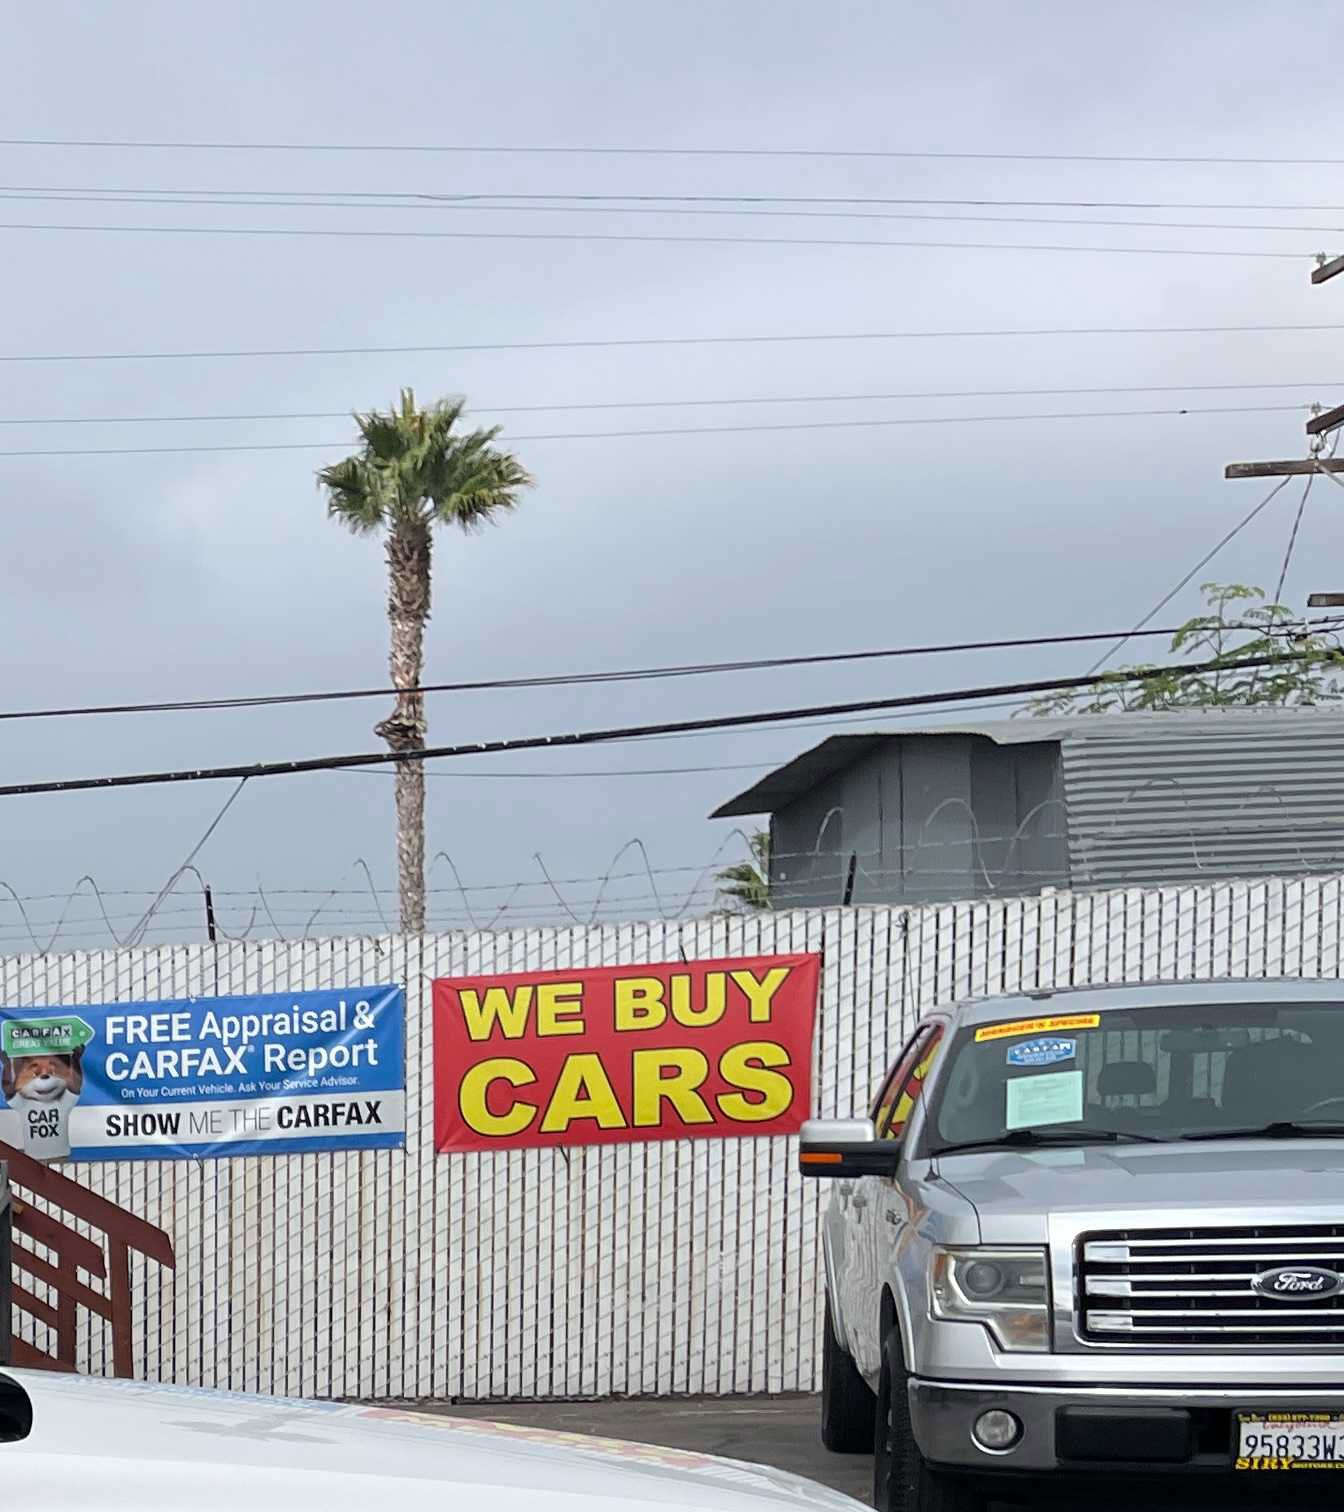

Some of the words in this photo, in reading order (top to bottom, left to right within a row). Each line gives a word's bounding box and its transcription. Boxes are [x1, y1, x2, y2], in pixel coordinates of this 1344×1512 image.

[105, 1012, 192, 1046] FREE
[198, 1001, 347, 1045] Appraisal
[352, 1000, 376, 1030] &
[458, 981, 586, 1042] WE
[613, 967, 795, 1033] BUY
[263, 1038, 379, 1076] Report
[121, 1087, 136, 1099] On
[137, 1086, 160, 1099] Your
[161, 1085, 198, 1098] Current
[199, 1083, 235, 1095] Vehicle.
[238, 1081, 257, 1093] Ask
[258, 1080, 281, 1092] Your
[282, 1078, 319, 1091] Service
[458, 1040, 795, 1138] CARS
[27, 1108, 60, 1124] CAR
[29, 1123, 60, 1139] FOX
[105, 1112, 181, 1137] SHOW
[189, 1109, 222, 1134] ME
[228, 1106, 271, 1133] THE
[276, 1100, 383, 1130] CARFAX
[1273, 1272, 1325, 1291] Ford
